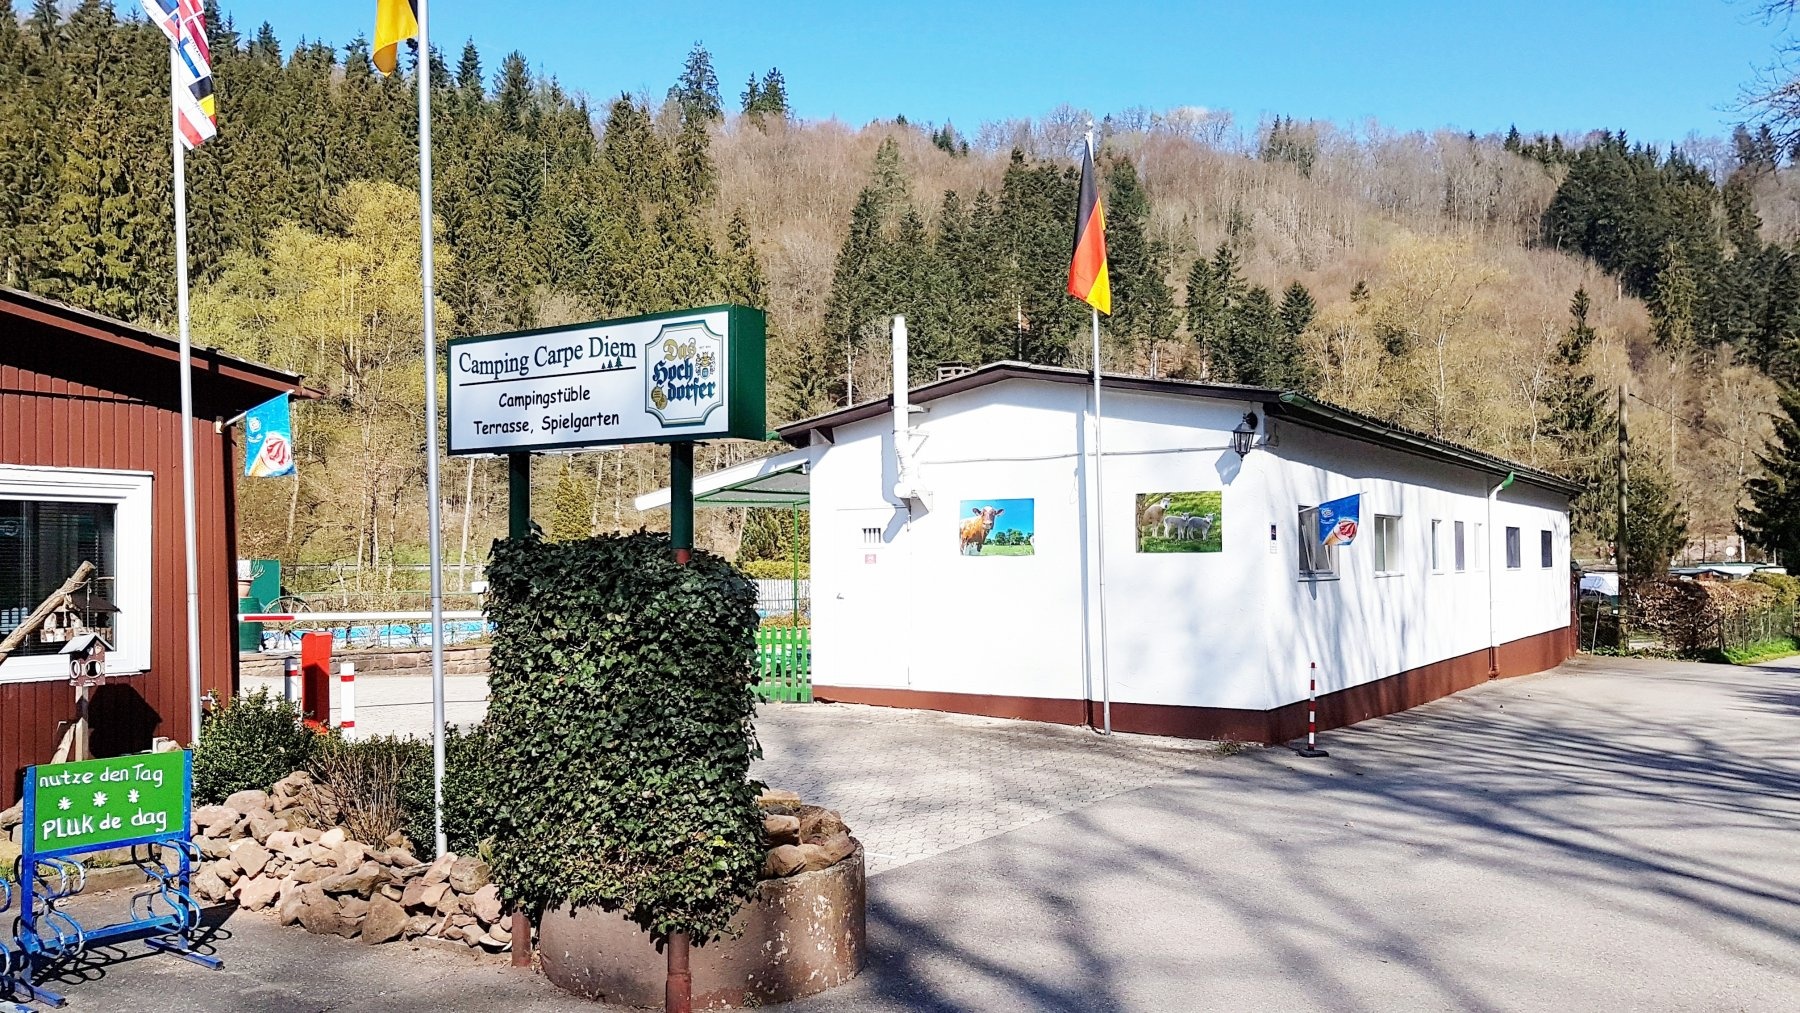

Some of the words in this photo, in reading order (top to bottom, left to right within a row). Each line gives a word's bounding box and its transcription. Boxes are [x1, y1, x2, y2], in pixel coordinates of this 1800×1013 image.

[459, 352, 530, 380] Camping
[534, 344, 583, 368] Carpe
[589, 336, 637, 358] Diem
[663, 337, 697, 361] Das
[652, 358, 694, 385] Hoch
[499, 385, 591, 410] Campingstüble
[667, 377, 716, 406] dorfer
[473, 420, 534, 435] Terrasse,
[541, 412, 620, 435] Spielgarten
[39, 770, 94, 788] nutze
[100, 767, 129, 782] den
[132, 764, 164, 788] Tag
[99, 813, 122, 830] de
[131, 808, 168, 833] dag
